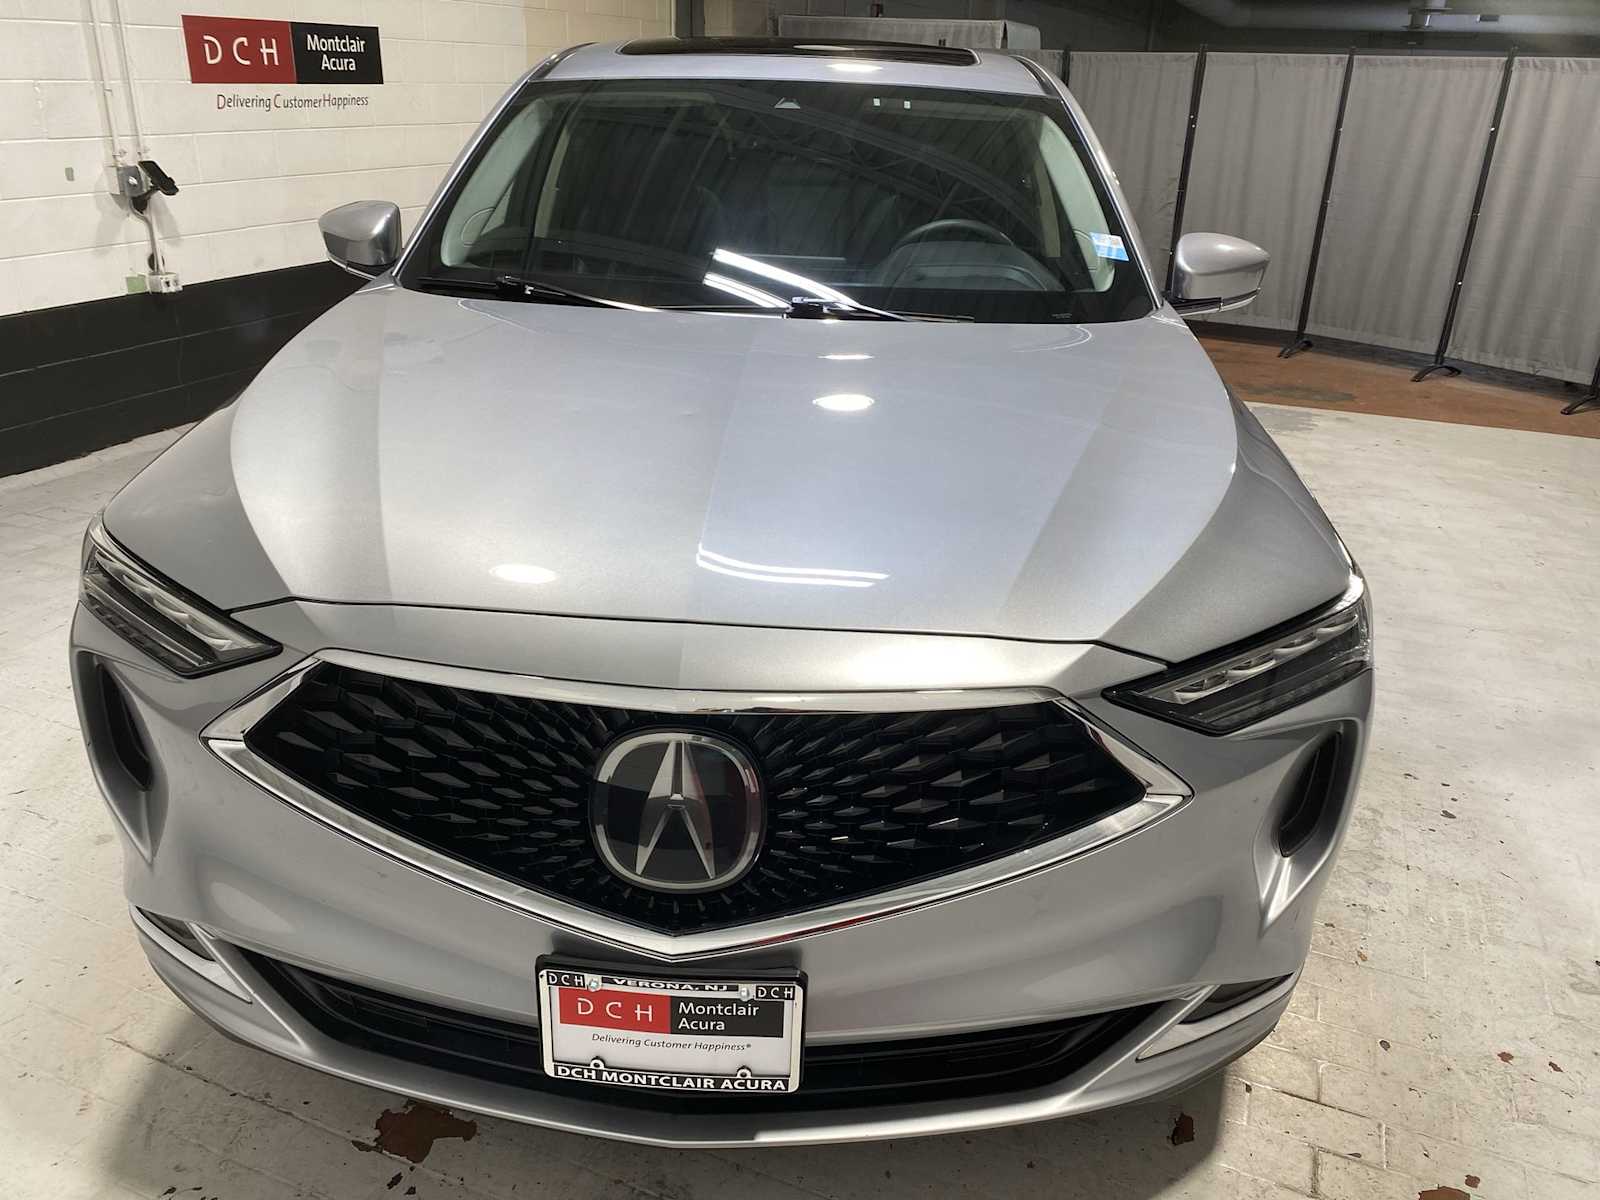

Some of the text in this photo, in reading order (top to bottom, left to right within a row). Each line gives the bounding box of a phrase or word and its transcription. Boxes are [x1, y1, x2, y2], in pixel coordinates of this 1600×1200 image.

[307, 34, 366, 53] Montclair
[321, 55, 356, 71] Acura
[217, 94, 271, 112] Delivering
[548, 973, 584, 986] DCH
[757, 986, 794, 999] DCH
[678, 1001, 760, 1016] Montclair
[678, 1017, 726, 1031] Acura
[592, 1033, 641, 1047] Delivering
[643, 1039, 692, 1049] Customer
[557, 1066, 786, 1090] DCH MONTCLAIR ACURA
